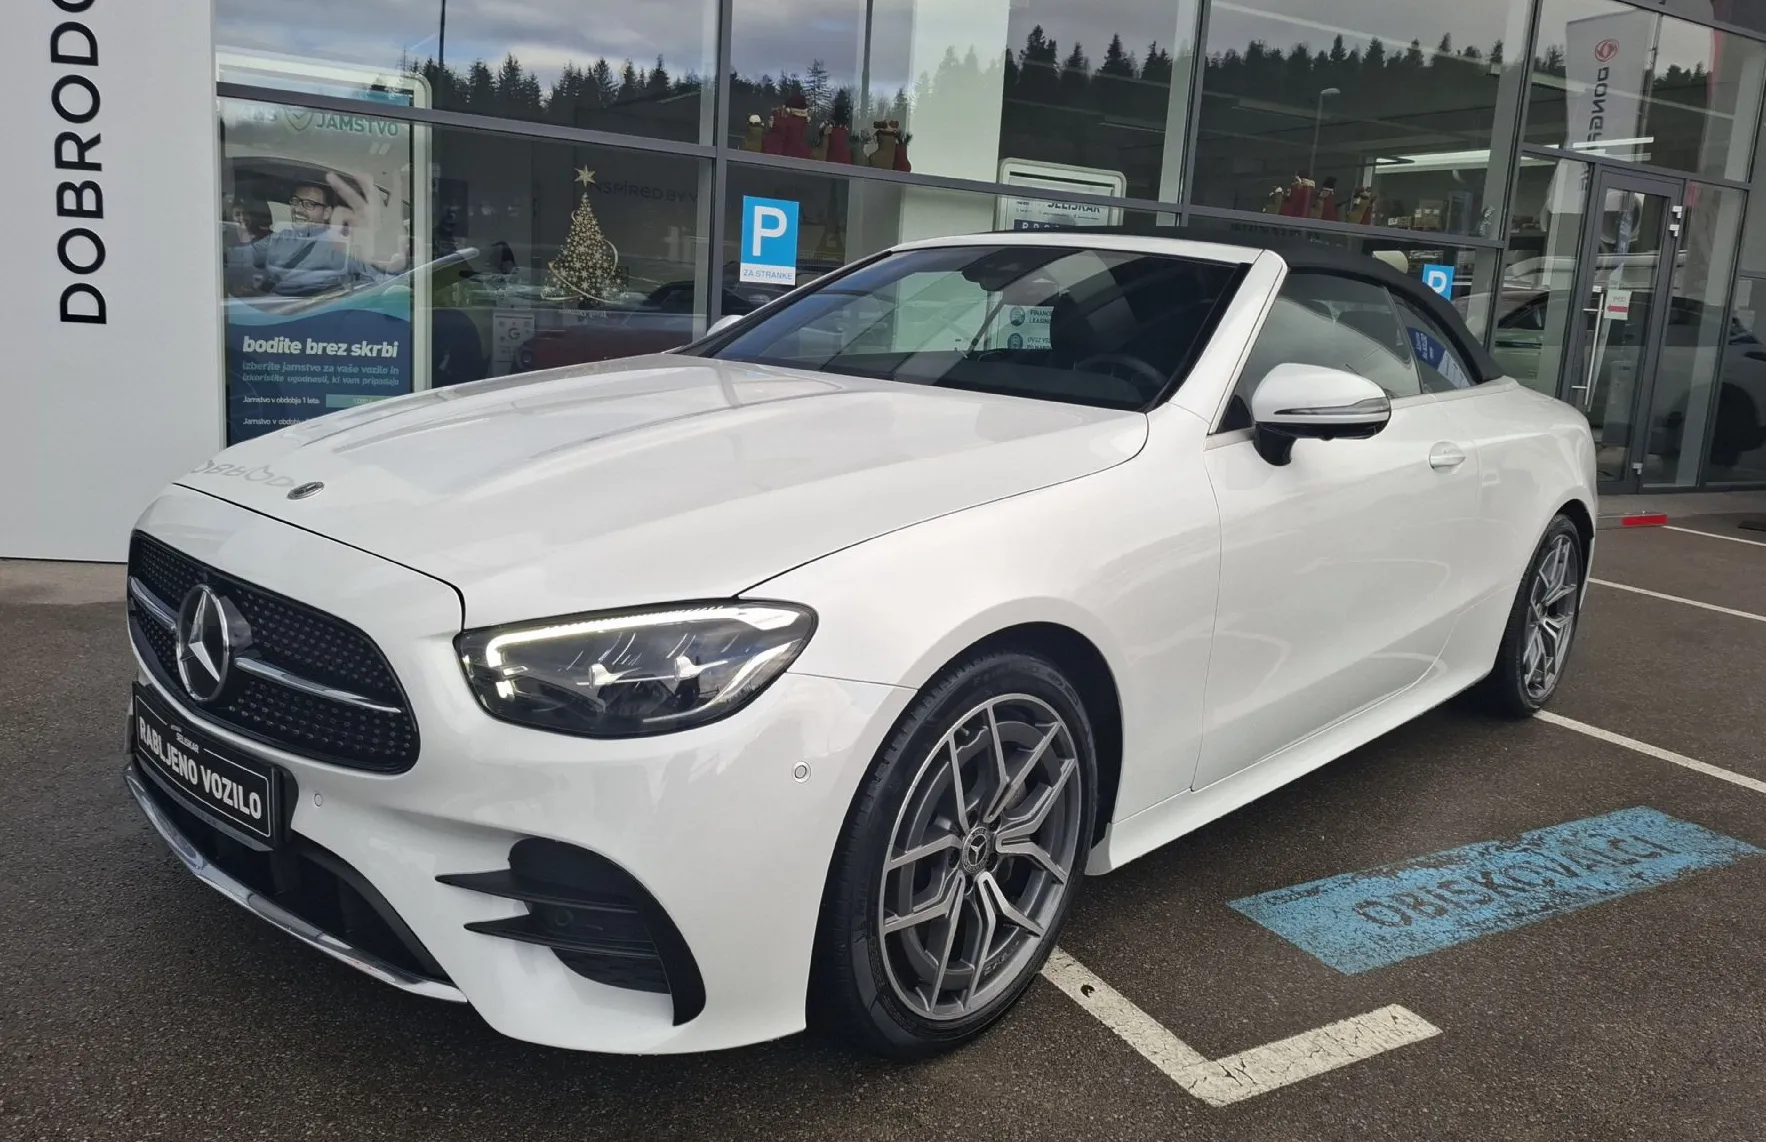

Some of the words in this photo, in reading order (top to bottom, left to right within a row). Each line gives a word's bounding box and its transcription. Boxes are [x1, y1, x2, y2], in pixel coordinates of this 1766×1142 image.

[317, 111, 399, 137] JAMSTVO
[50, 0, 107, 324] DOBROD
[752, 205, 788, 257] P
[743, 268, 754, 277] ZA
[755, 269, 793, 280] STRANKE
[242, 335, 302, 354] bodite
[306, 338, 347, 356] brez
[350, 340, 399, 358] skrbi
[282, 361, 321, 373] jamstvo
[337, 363, 359, 373] vaše
[361, 365, 388, 375] vozilo
[389, 365, 399, 375] in
[342, 376, 360, 385] vam
[242, 395, 271, 403] Jamstvo
[242, 417, 271, 425] Jamstvo
[139, 716, 198, 785] RABLJENO
[200, 765, 262, 819] VOZILO
[1352, 834, 1681, 927] OBISKOVALCI
